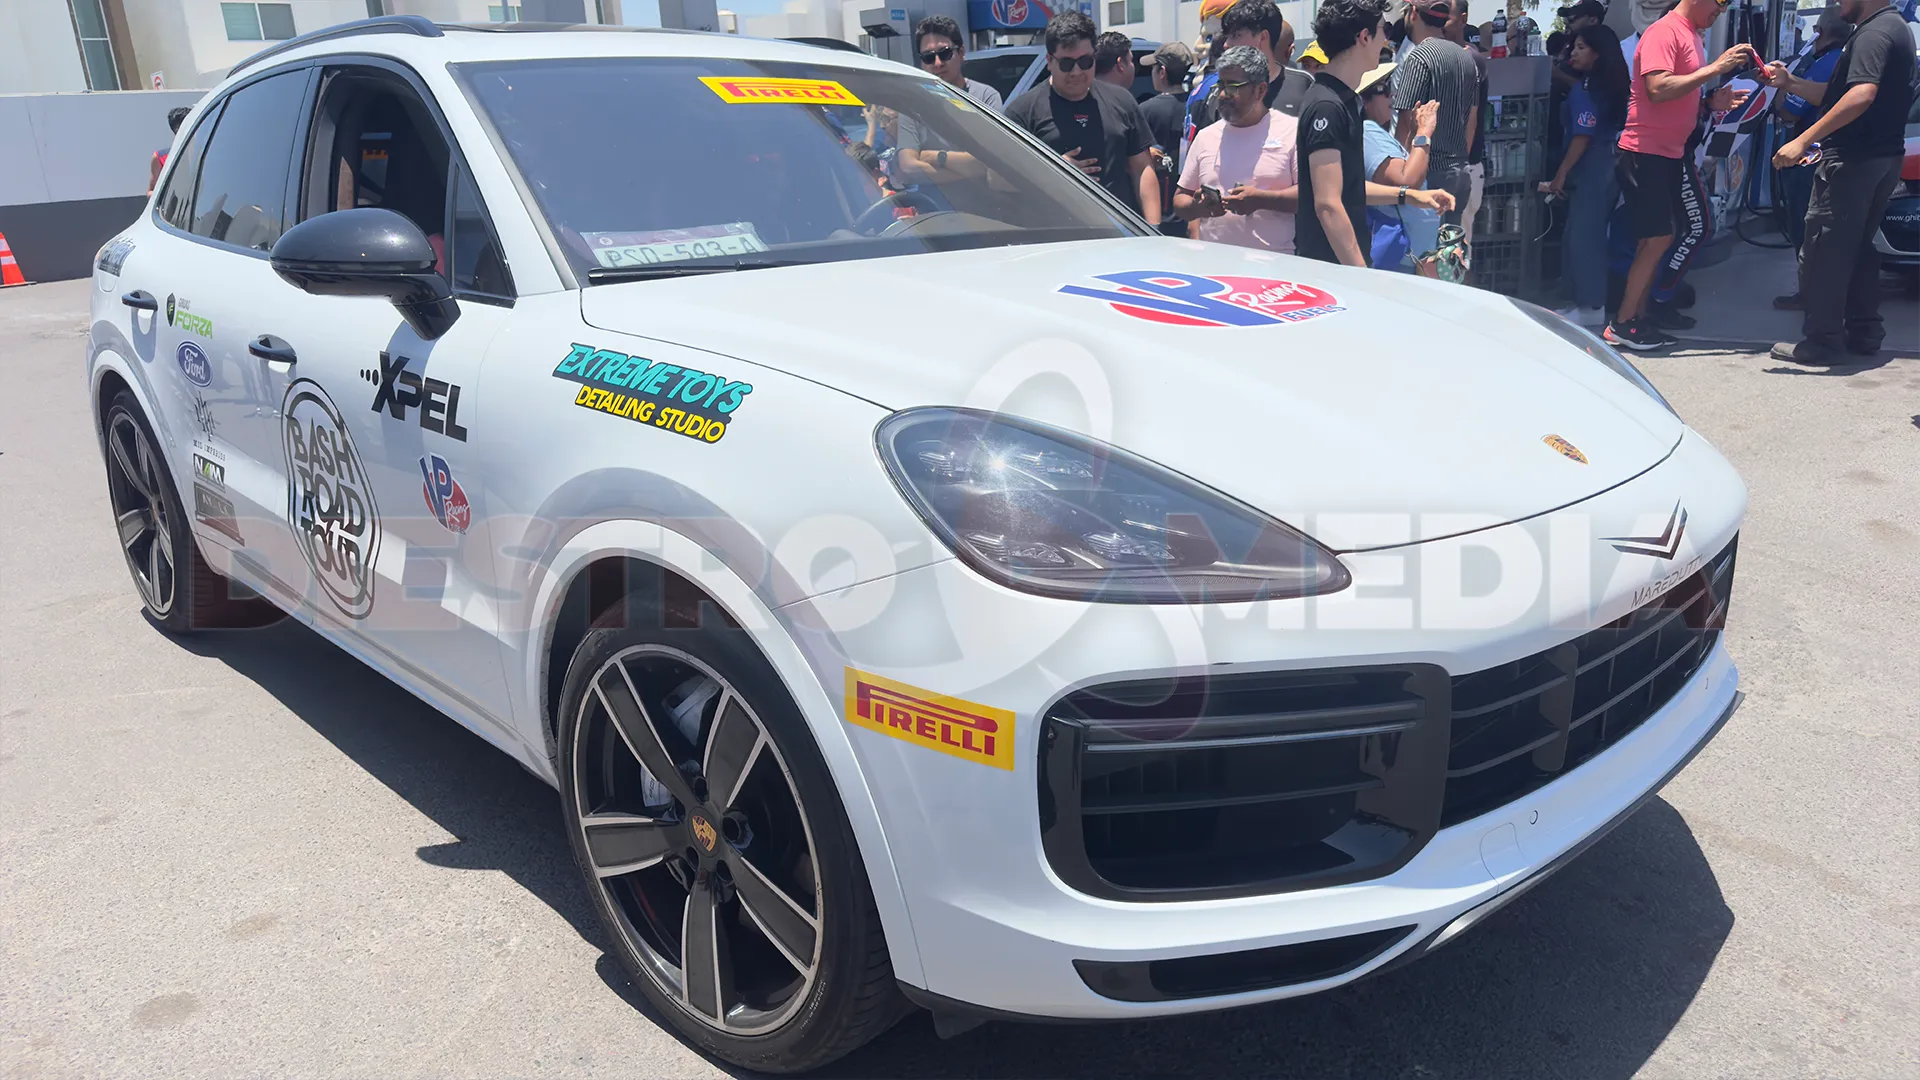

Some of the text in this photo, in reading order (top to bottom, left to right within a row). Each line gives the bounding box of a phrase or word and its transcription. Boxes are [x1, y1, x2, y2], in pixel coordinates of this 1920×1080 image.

[719, 81, 847, 100] PIRELLI
[175, 310, 213, 340] FORZA
[1056, 270, 1286, 327] VP
[1228, 281, 1317, 313] Racing
[1280, 304, 1347, 320] FUELS
[184, 347, 206, 381] Ford
[555, 343, 753, 414] EXTREME TOYS
[371, 350, 467, 443] XPEL
[575, 385, 727, 444] DETAILING STUDIO
[284, 414, 356, 484] BASH
[297, 465, 366, 538] ROAD
[418, 452, 453, 529] VP
[857, 680, 999, 757] PIRELLI
